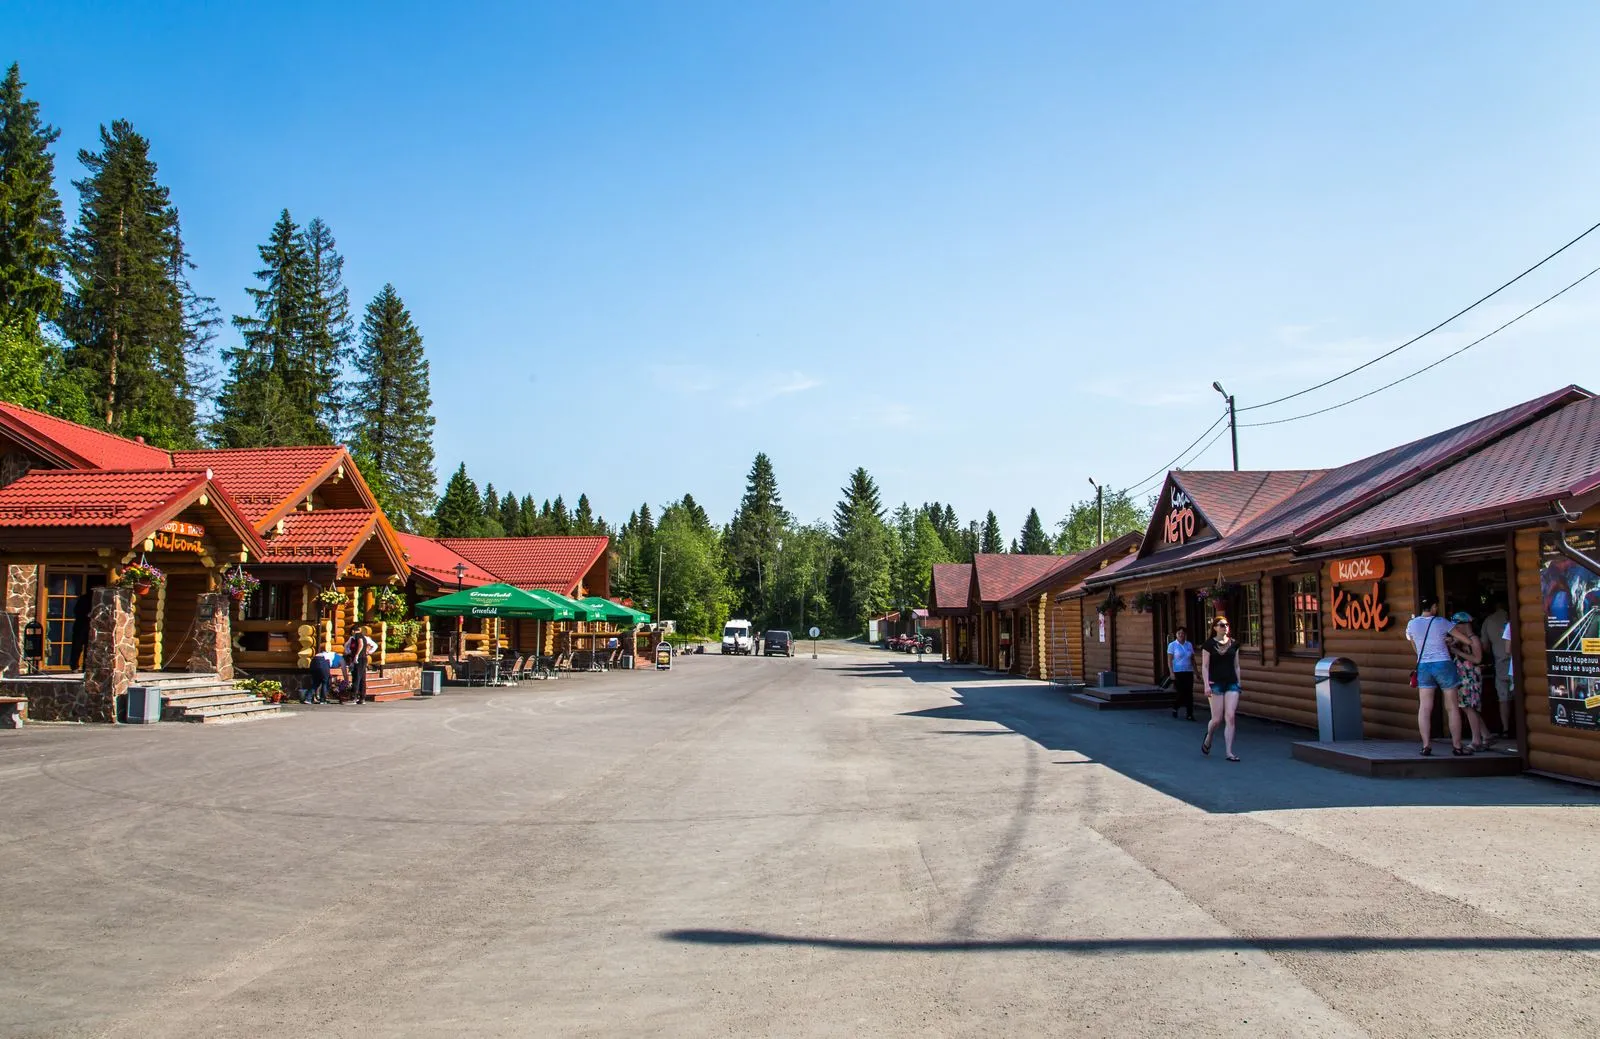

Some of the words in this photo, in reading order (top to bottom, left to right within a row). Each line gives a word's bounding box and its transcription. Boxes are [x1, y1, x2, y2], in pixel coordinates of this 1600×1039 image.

[154, 533, 204, 553] Welcome
[1330, 582, 1389, 632] Kiosk
[1555, 655, 1572, 663] Такой
